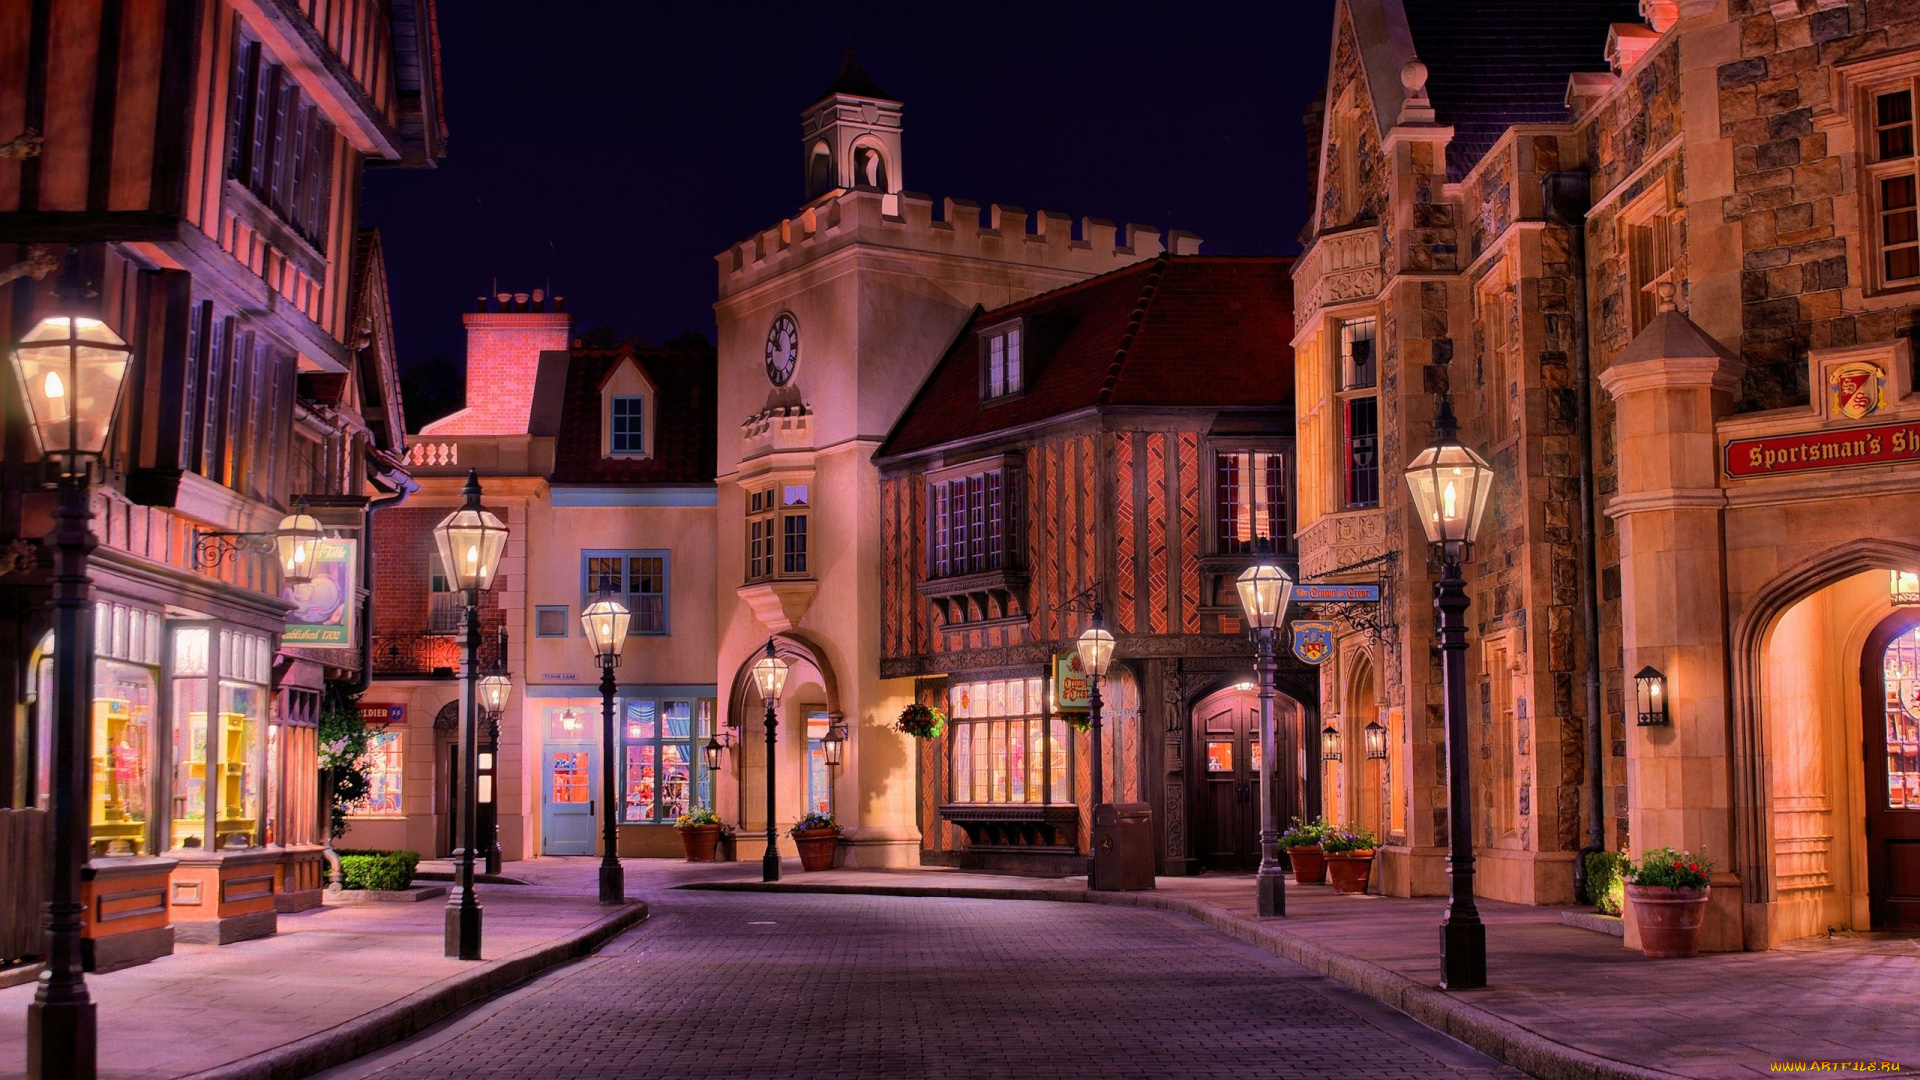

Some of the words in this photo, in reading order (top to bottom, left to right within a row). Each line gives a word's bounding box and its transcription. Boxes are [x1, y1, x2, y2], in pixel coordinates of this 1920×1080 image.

[1749, 433, 1882, 470] Sportsman's
[1309, 586, 1336, 599] Crown
[1338, 589, 1345, 598] &
[1346, 587, 1370, 599] Crest
[360, 708, 388, 718] LDIER
